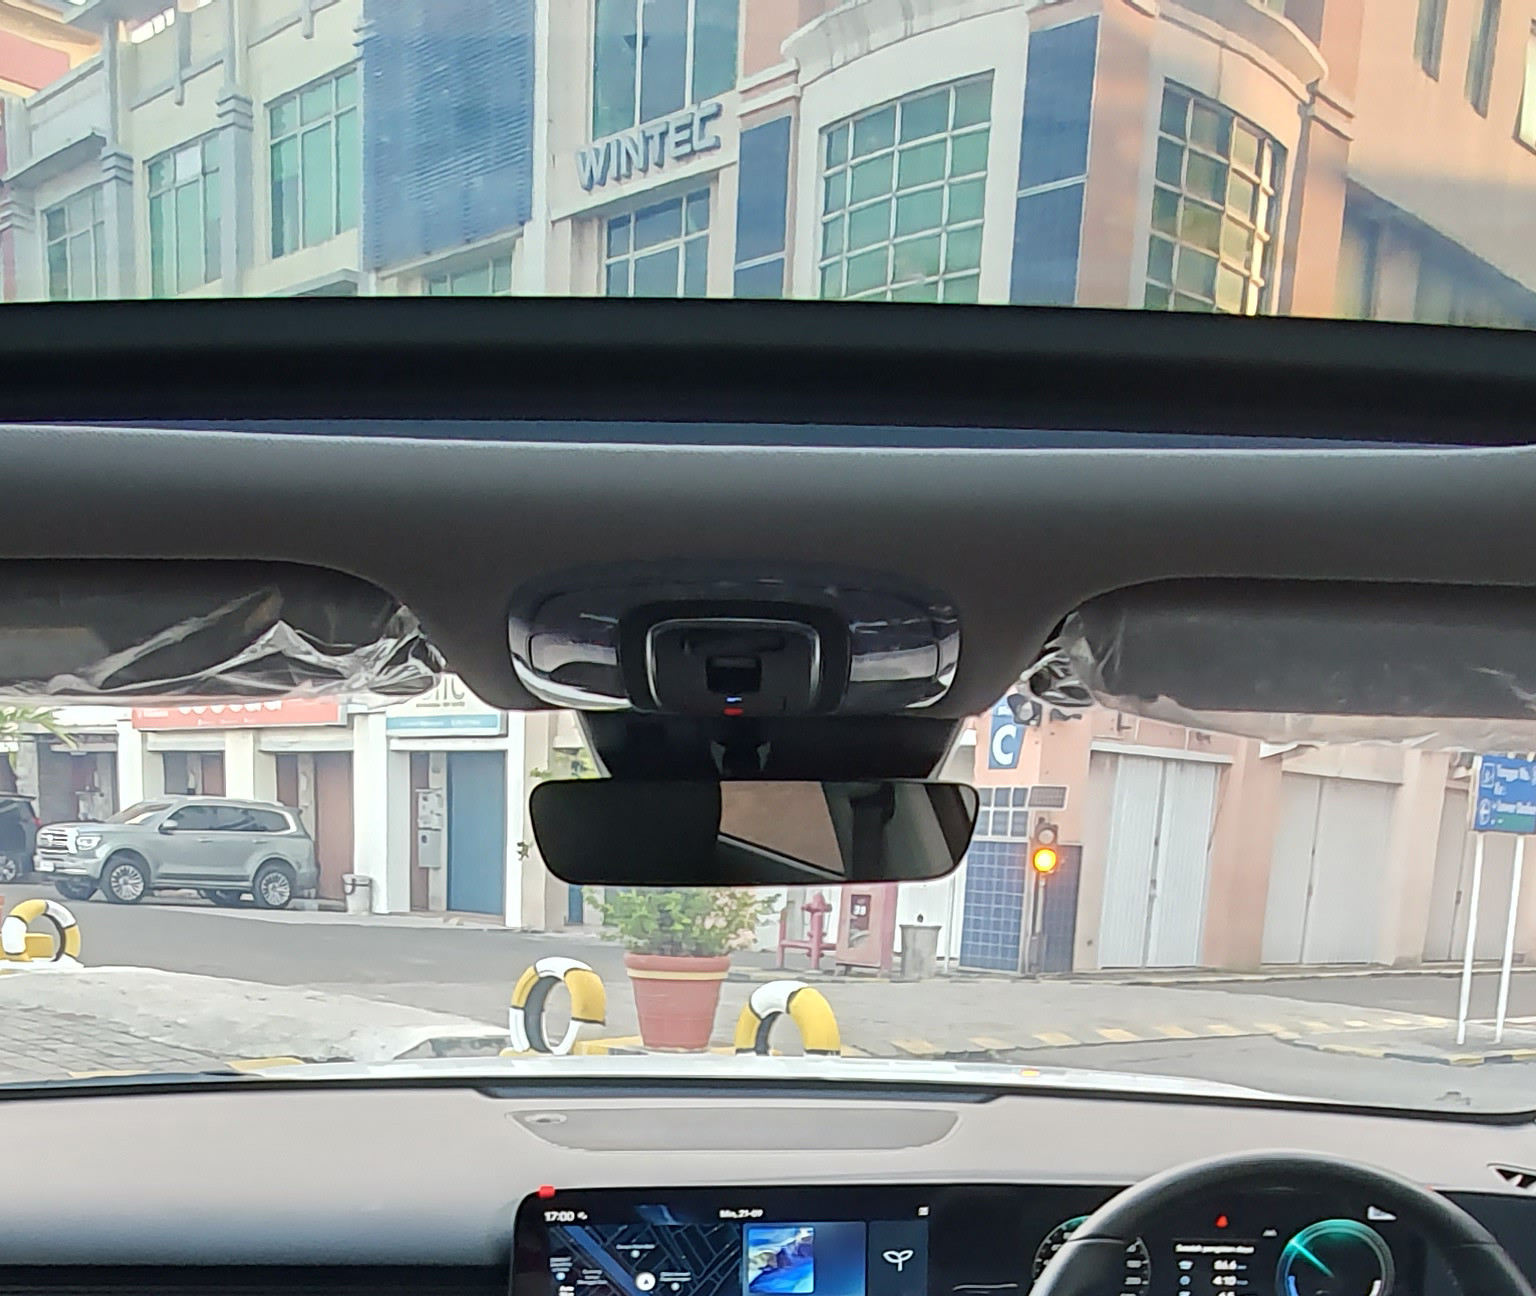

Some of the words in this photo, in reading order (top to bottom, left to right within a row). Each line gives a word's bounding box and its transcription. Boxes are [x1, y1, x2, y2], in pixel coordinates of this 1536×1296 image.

[575, 101, 723, 191] WINTEC
[992, 723, 1017, 766] C
[544, 1211, 575, 1222] 17:00
